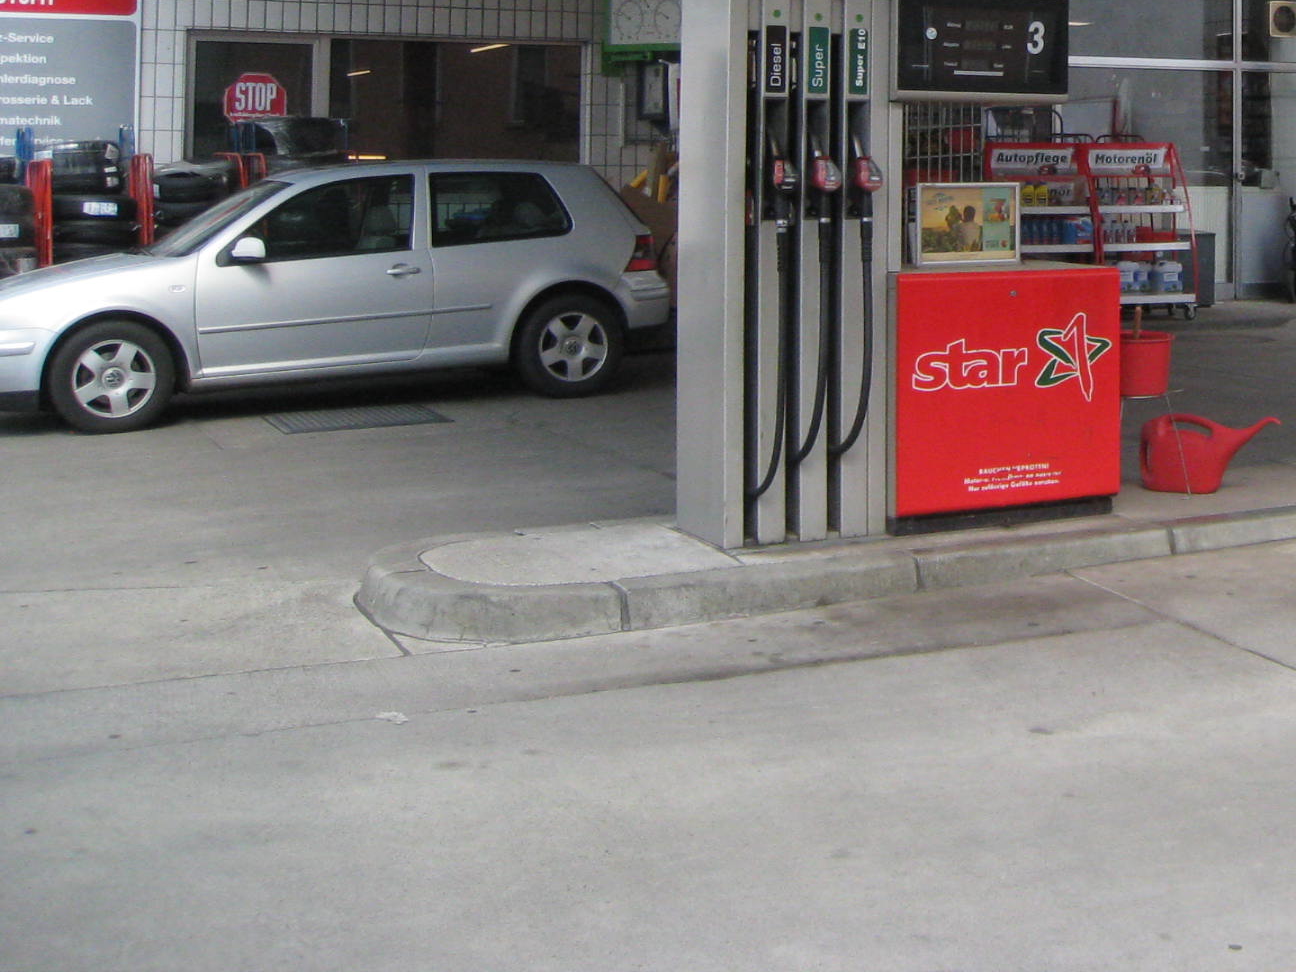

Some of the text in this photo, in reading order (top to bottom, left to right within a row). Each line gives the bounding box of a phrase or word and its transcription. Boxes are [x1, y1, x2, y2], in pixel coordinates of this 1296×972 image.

[1026, 21, 1046, 55] 3
[770, 43, 782, 87] Diesel
[812, 44, 826, 87] Super
[855, 29, 866, 87] Super E10
[51, 95, 60, 106] &
[63, 95, 93, 106] Lack
[235, 82, 277, 111] STOP
[997, 151, 1067, 165] Autopflege
[1095, 152, 1158, 165] Motorenöl
[912, 338, 1028, 391] star
